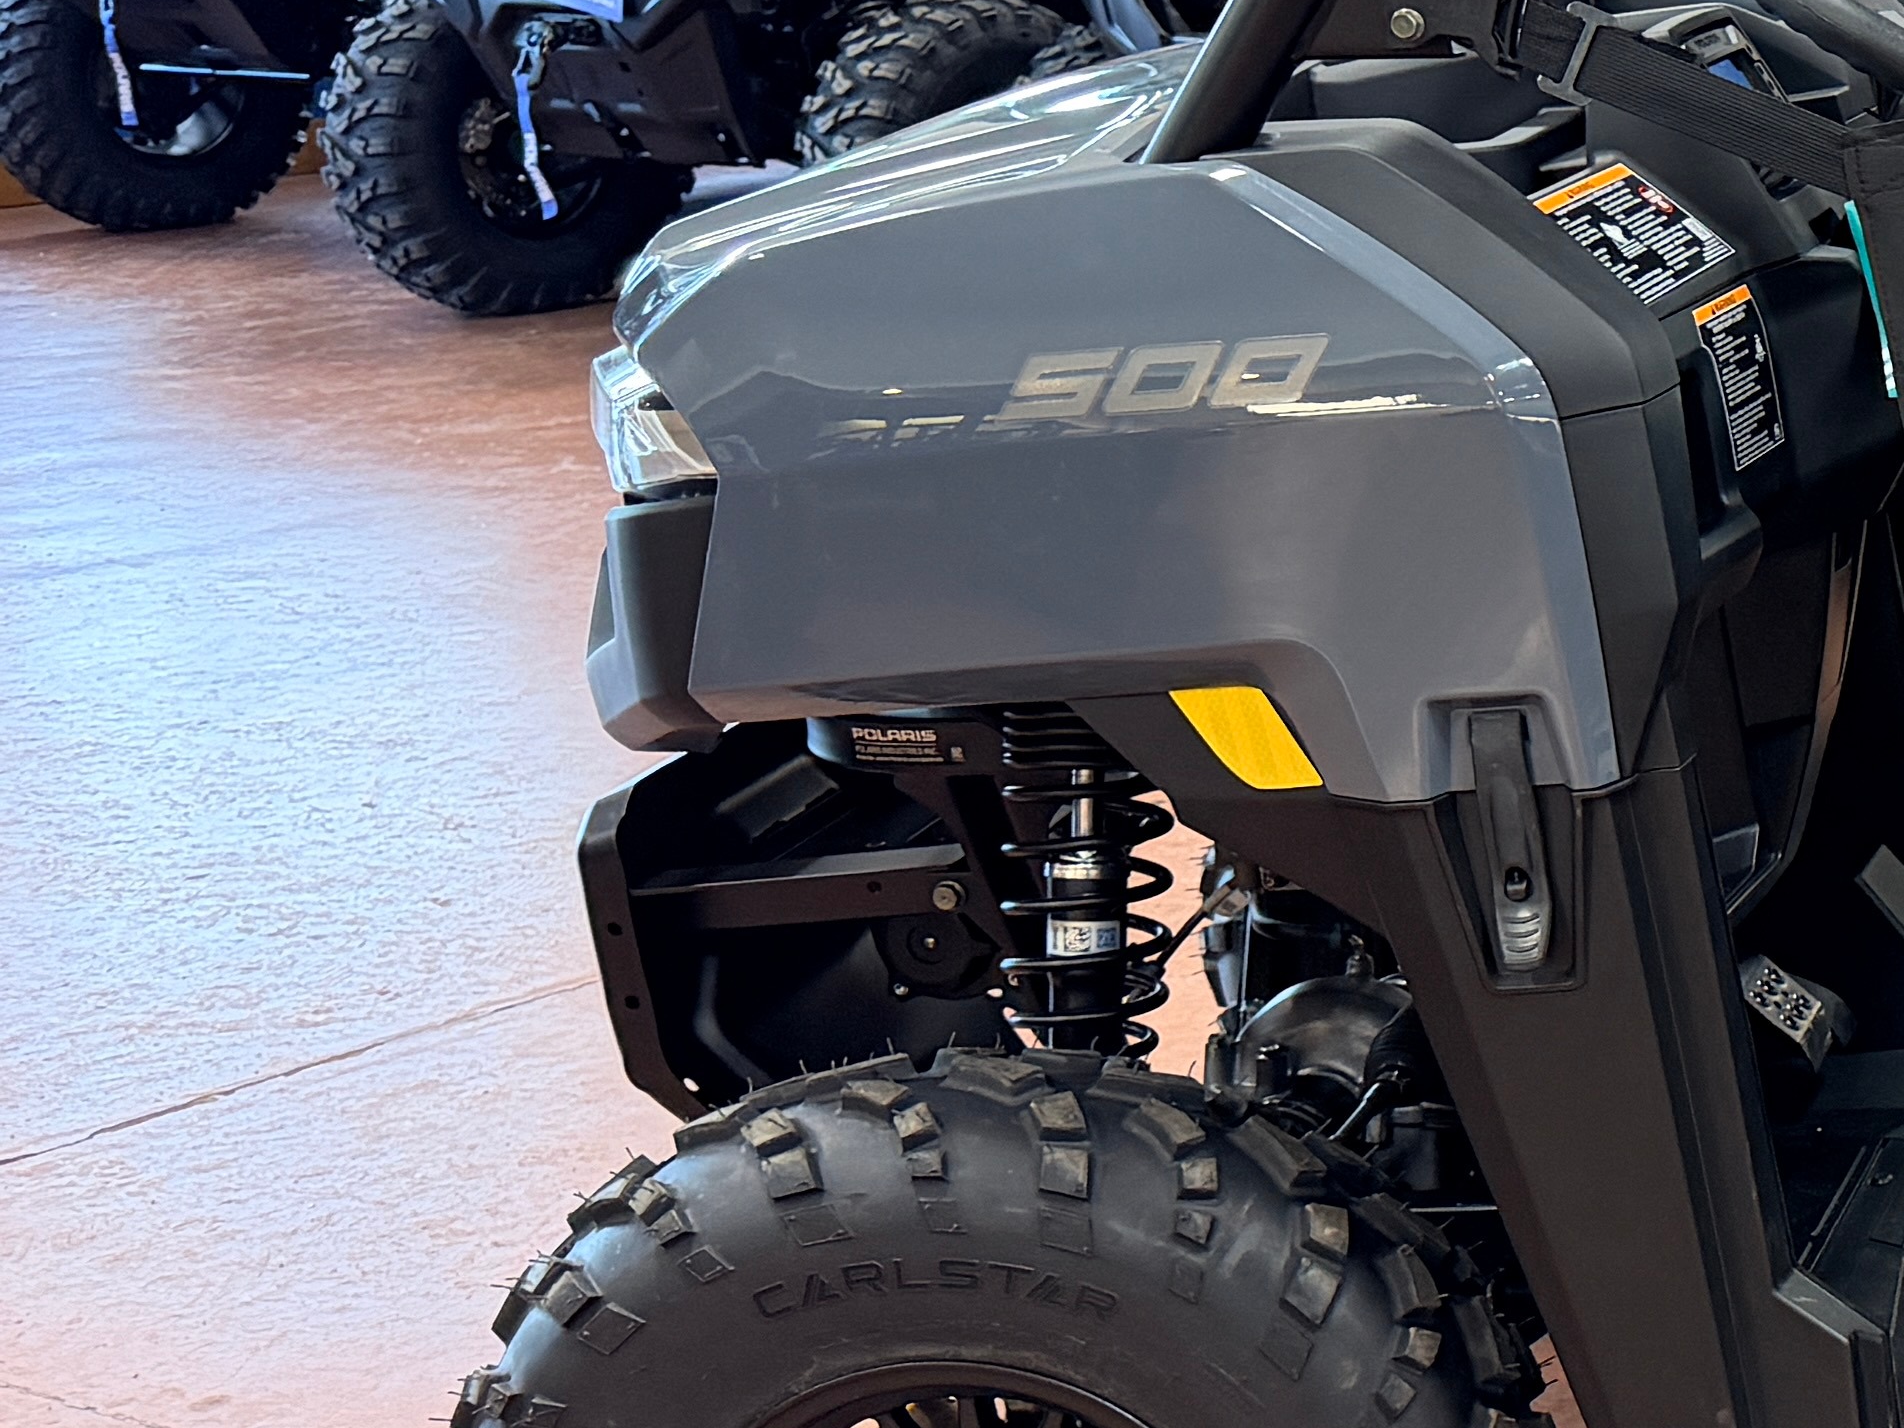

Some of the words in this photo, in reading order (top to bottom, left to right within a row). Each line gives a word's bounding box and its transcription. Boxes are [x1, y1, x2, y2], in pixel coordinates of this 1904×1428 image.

[998, 332, 1331, 421] 500
[851, 727, 937, 742] POLARIS
[752, 1258, 1120, 1320] CARLSTAR
